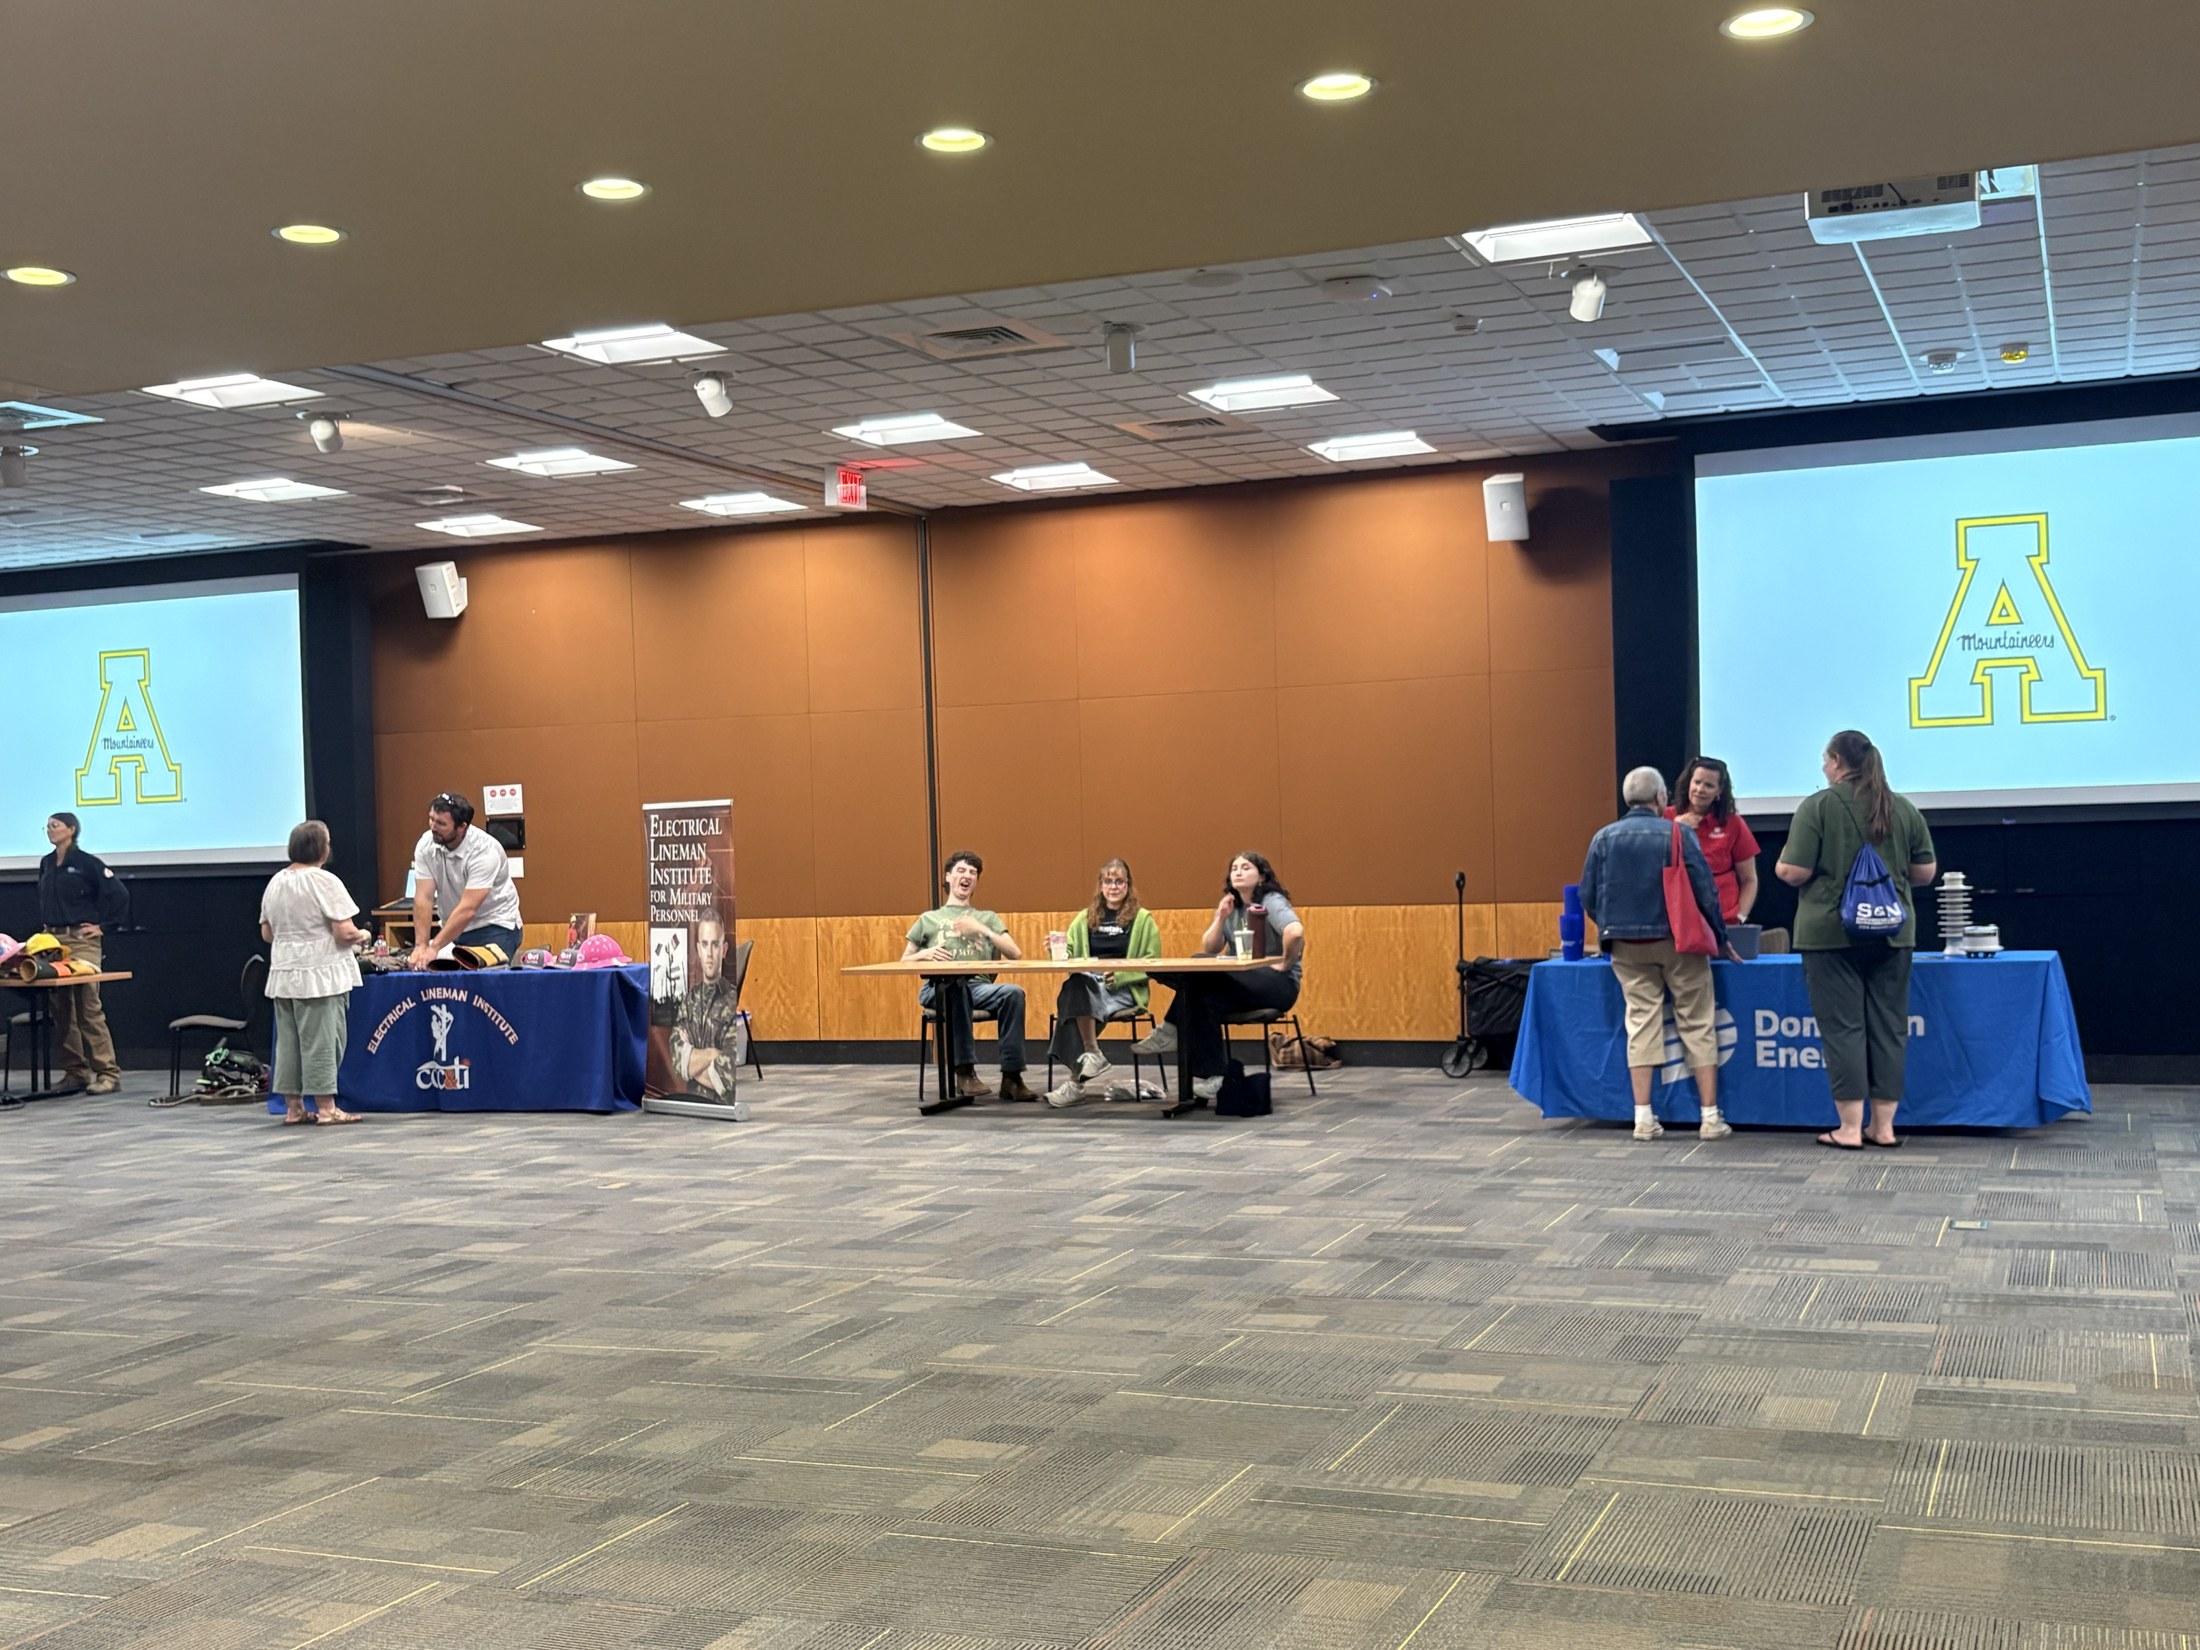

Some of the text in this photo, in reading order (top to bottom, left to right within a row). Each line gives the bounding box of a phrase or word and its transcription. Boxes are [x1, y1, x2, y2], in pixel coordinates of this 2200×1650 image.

[1908, 512, 2107, 729] A
[1956, 631, 2055, 651] Mountaineers
[75, 648, 183, 807] A
[101, 735, 155, 750] Mountaineers
[1856, 901, 1902, 918] S&N
[367, 987, 519, 1055] ELECTRICAL LINEMAN INSTITUTE
[1754, 1009, 1925, 1038] Domn
[1755, 1040, 1827, 1069] Ene
